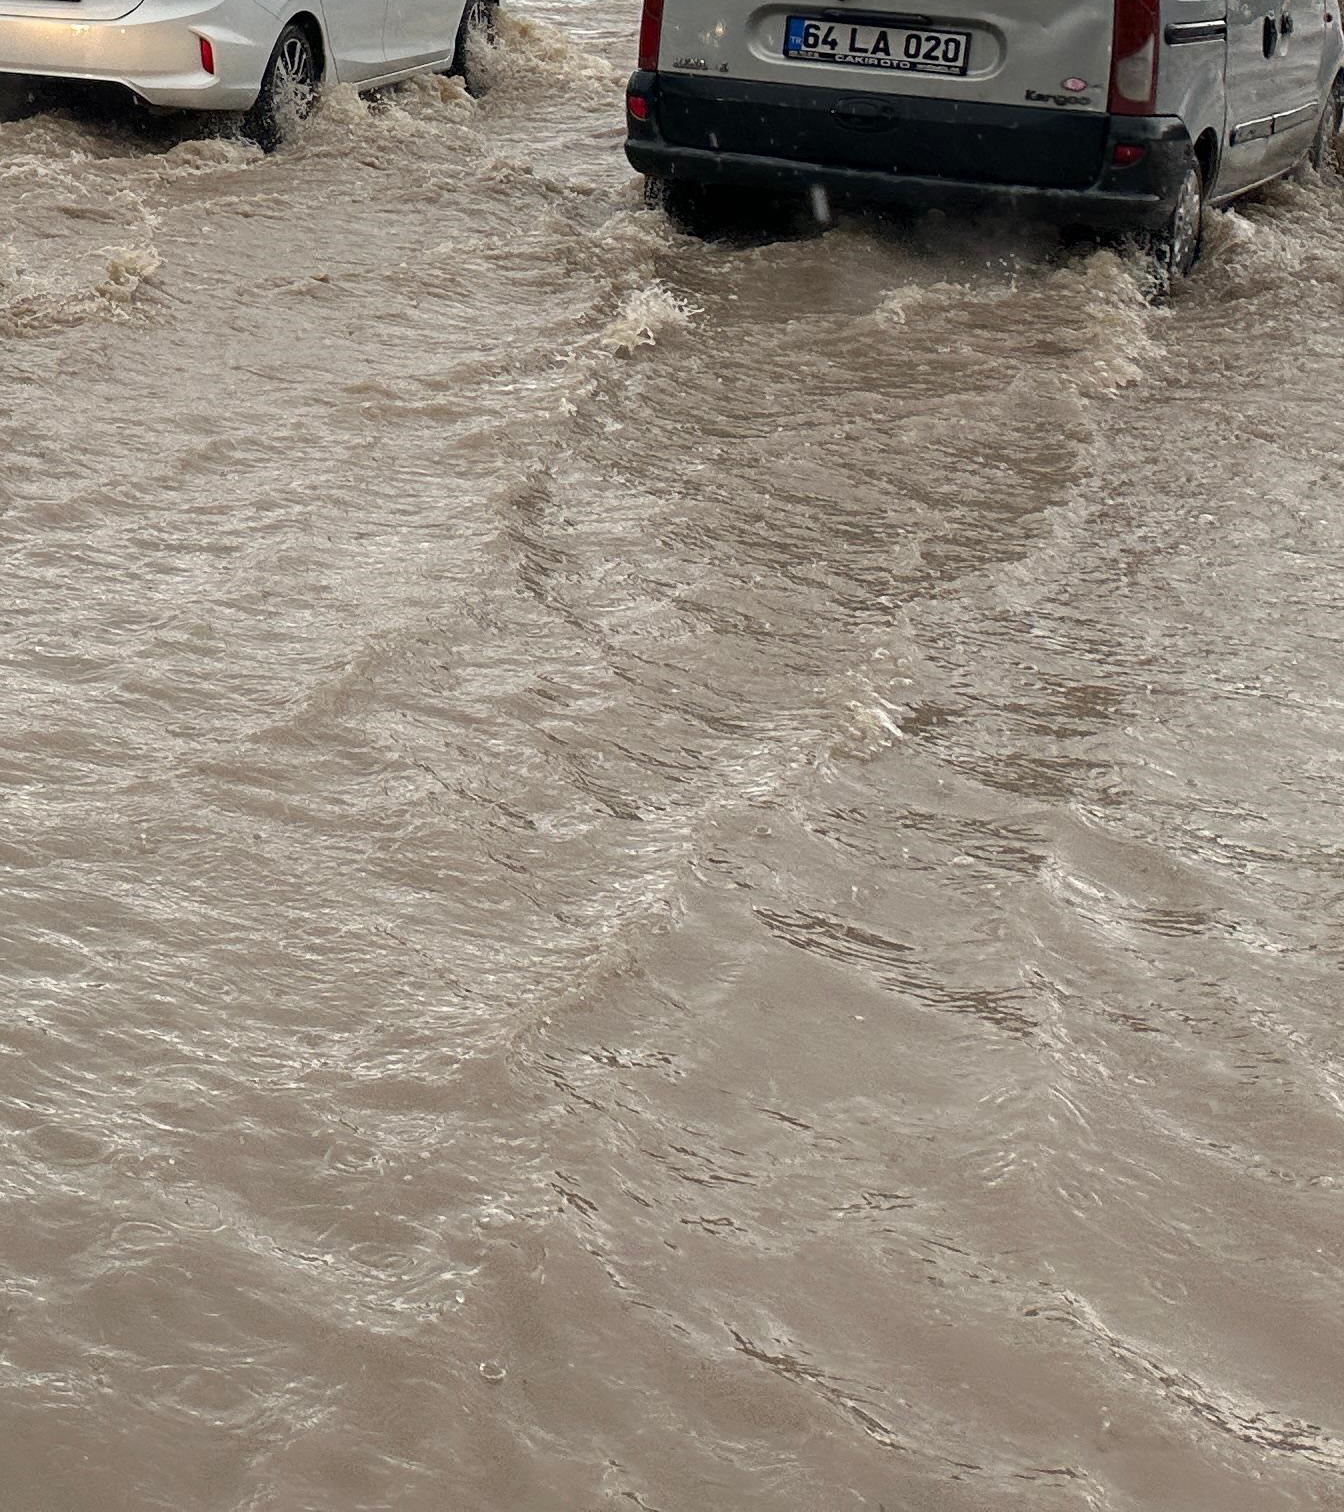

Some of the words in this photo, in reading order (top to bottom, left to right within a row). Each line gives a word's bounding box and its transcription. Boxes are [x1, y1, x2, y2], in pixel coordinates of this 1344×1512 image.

[803, 23, 838, 51] 64
[848, 27, 891, 57] LA
[903, 33, 961, 63] 020
[880, 58, 910, 69] OTO
[1024, 89, 1091, 106] Kangoo
